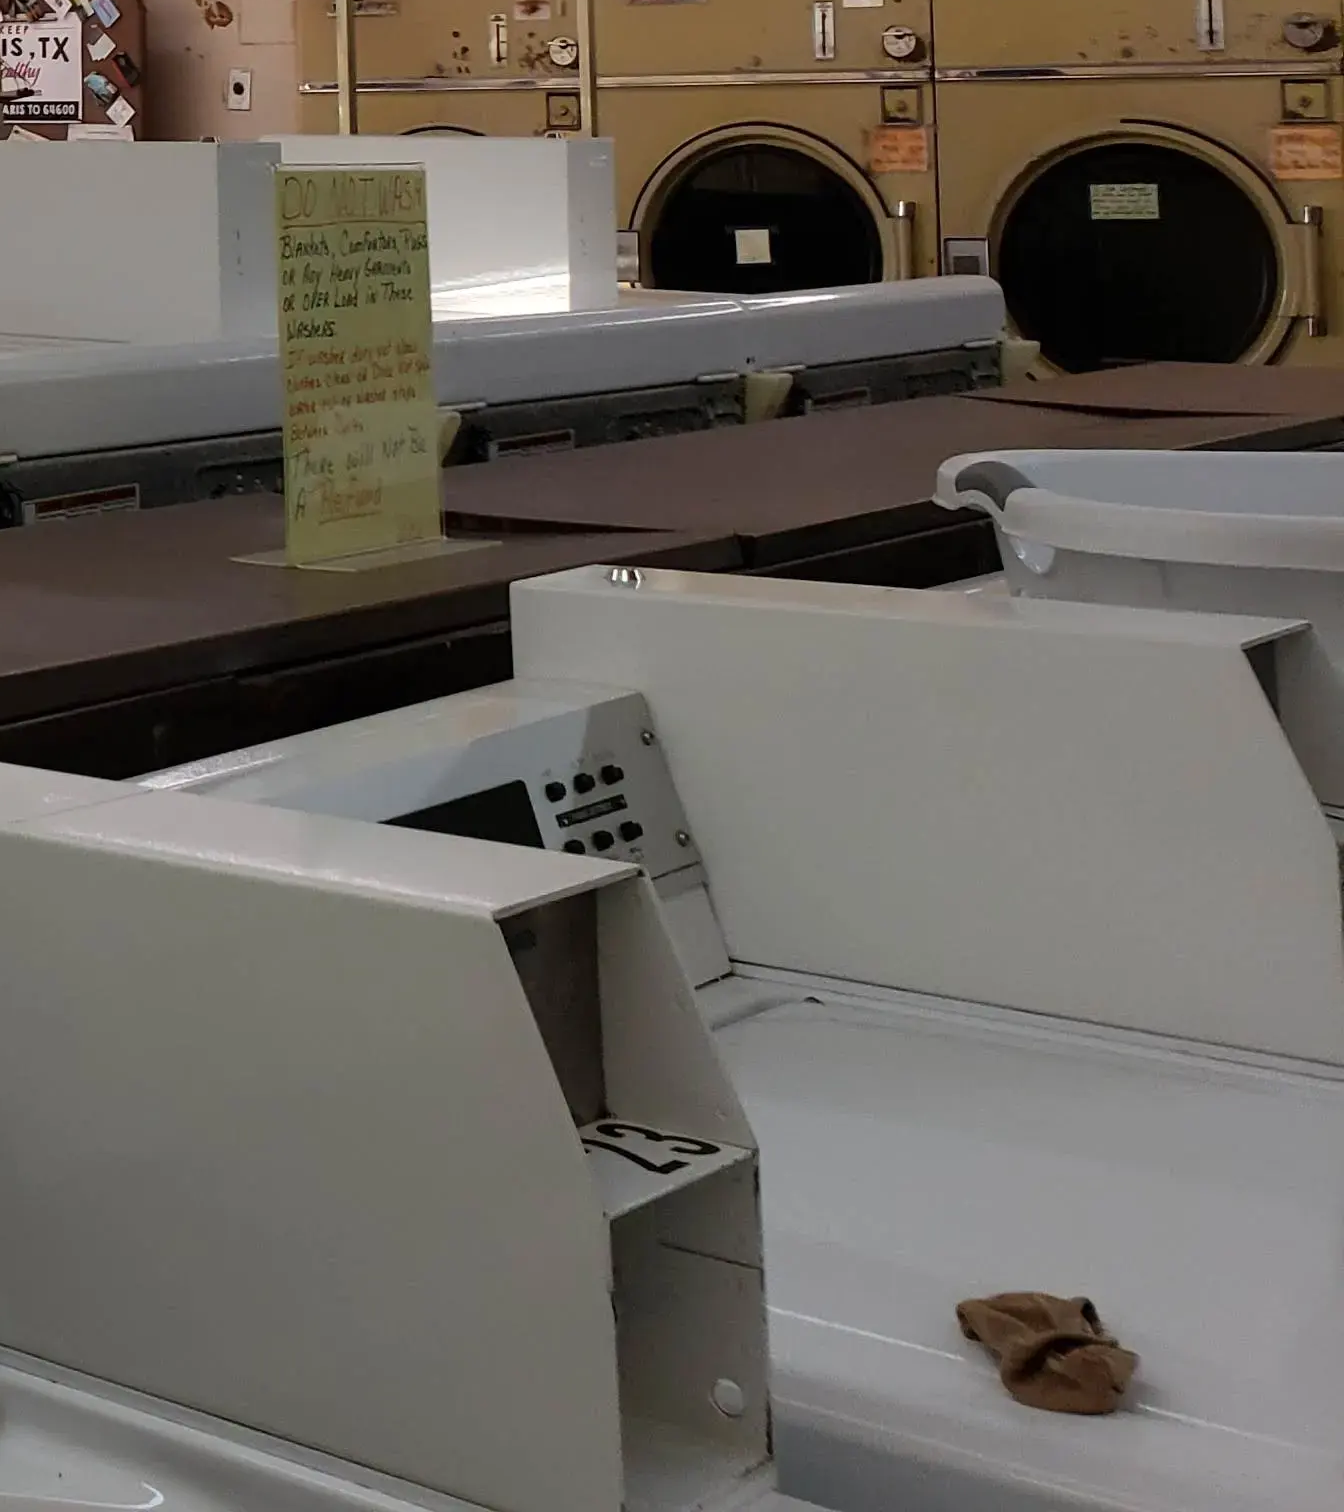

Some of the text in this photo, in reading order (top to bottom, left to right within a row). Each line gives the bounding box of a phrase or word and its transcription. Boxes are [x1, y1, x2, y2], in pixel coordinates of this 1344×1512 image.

[39, 36, 70, 63] TX
[27, 103, 41, 116] TO
[42, 103, 76, 116] 64600
[282, 177, 317, 220] DO
